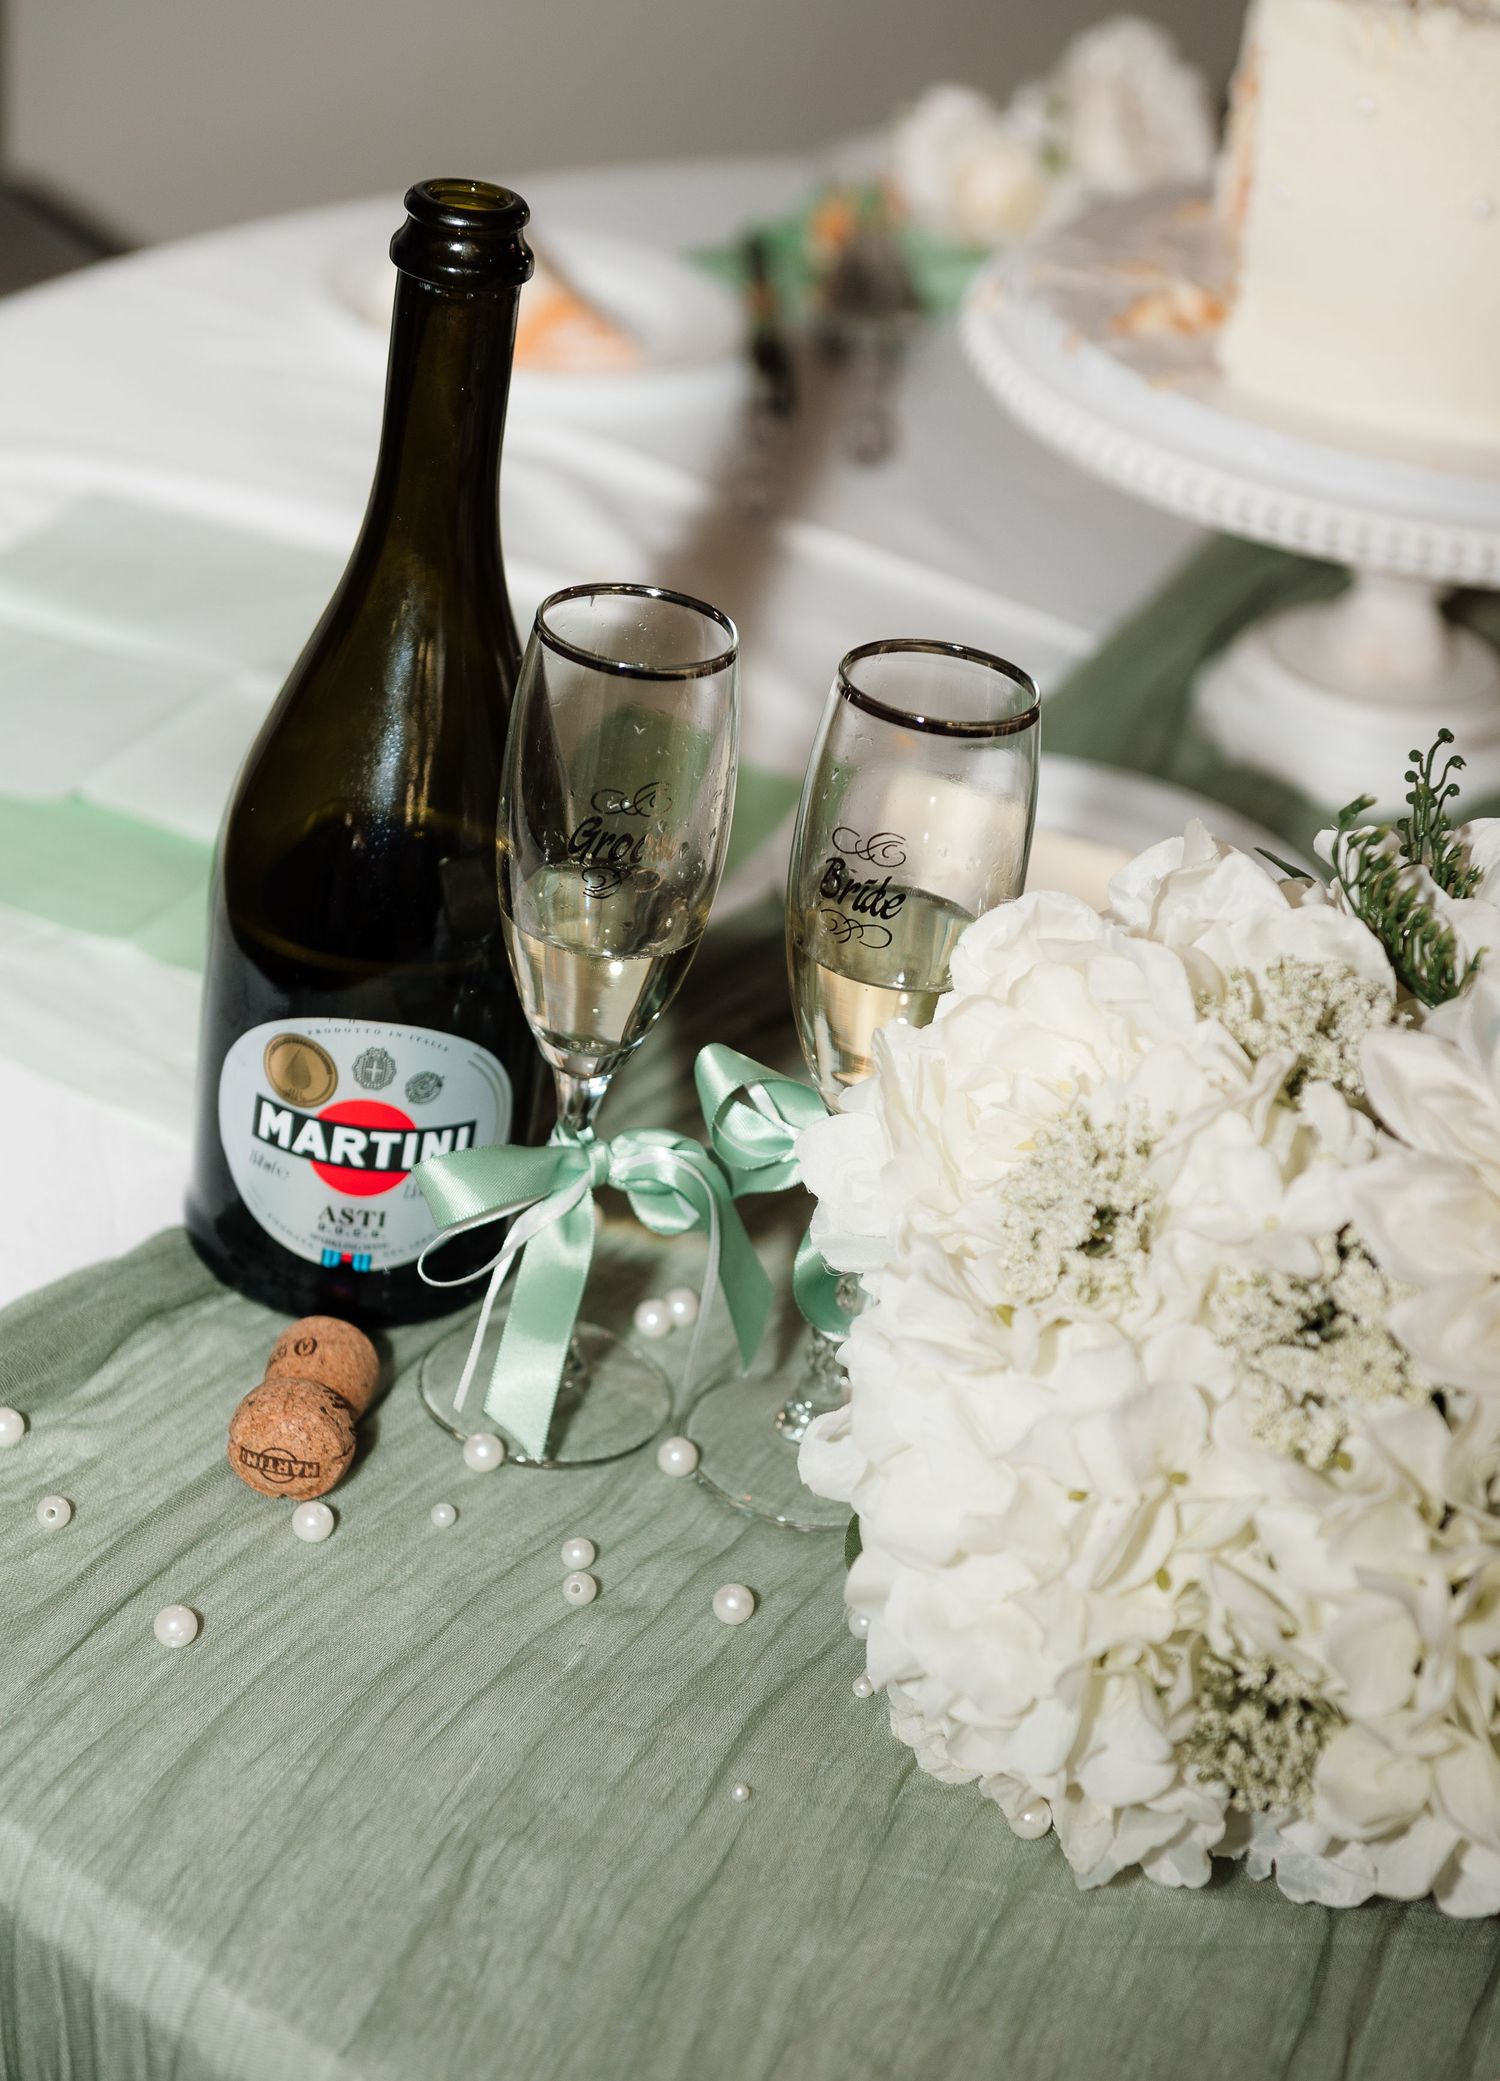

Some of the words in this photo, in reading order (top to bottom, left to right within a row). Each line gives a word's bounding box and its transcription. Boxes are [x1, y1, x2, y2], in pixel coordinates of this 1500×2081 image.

[819, 857, 907, 920] Bride
[307, 1026, 382, 1036] PRODOTTO
[257, 1099, 471, 1170] MARTINI
[317, 1205, 387, 1228] ASTI
[242, 1449, 319, 1477] MARTINI
